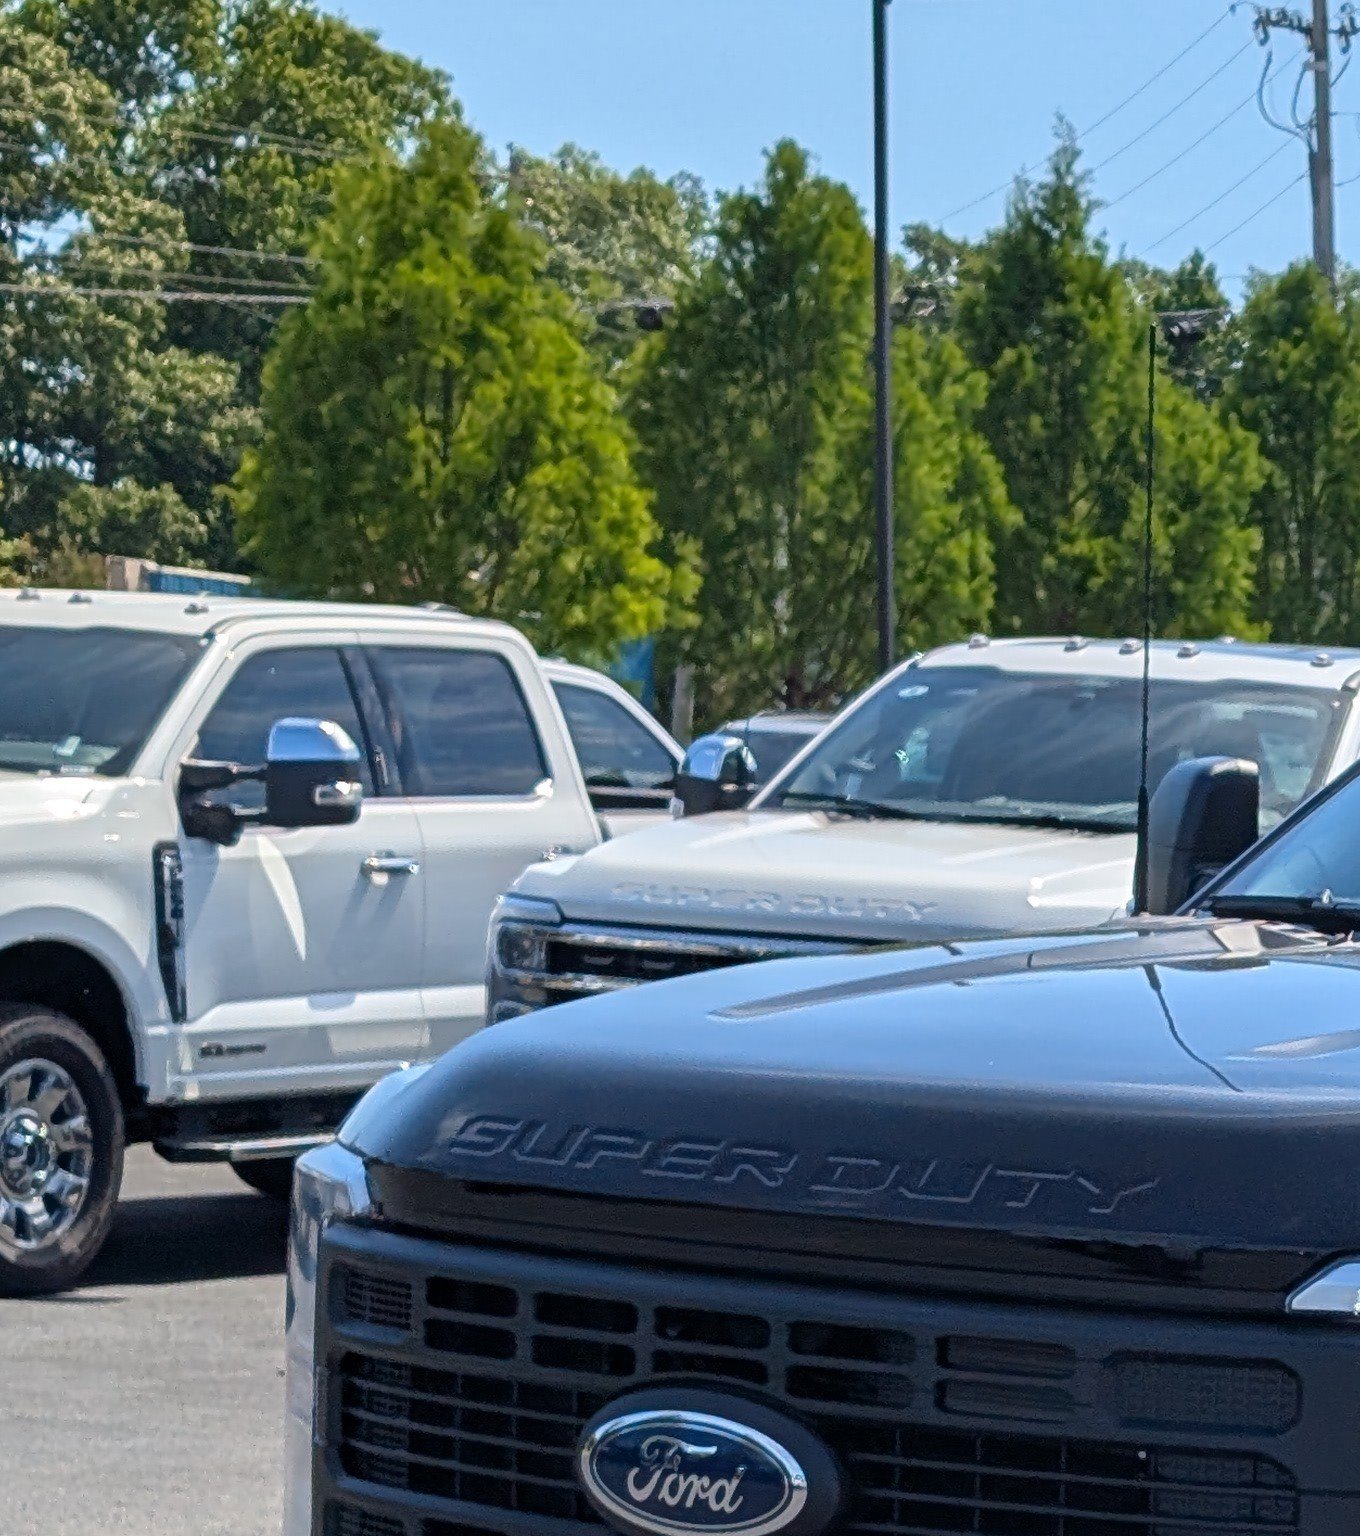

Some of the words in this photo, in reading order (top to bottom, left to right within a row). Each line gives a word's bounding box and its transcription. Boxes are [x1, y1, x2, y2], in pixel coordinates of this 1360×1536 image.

[450, 1114, 798, 1188] SUPER
[809, 1154, 1162, 1215] DUTY
[626, 1433, 748, 1514] Ford
